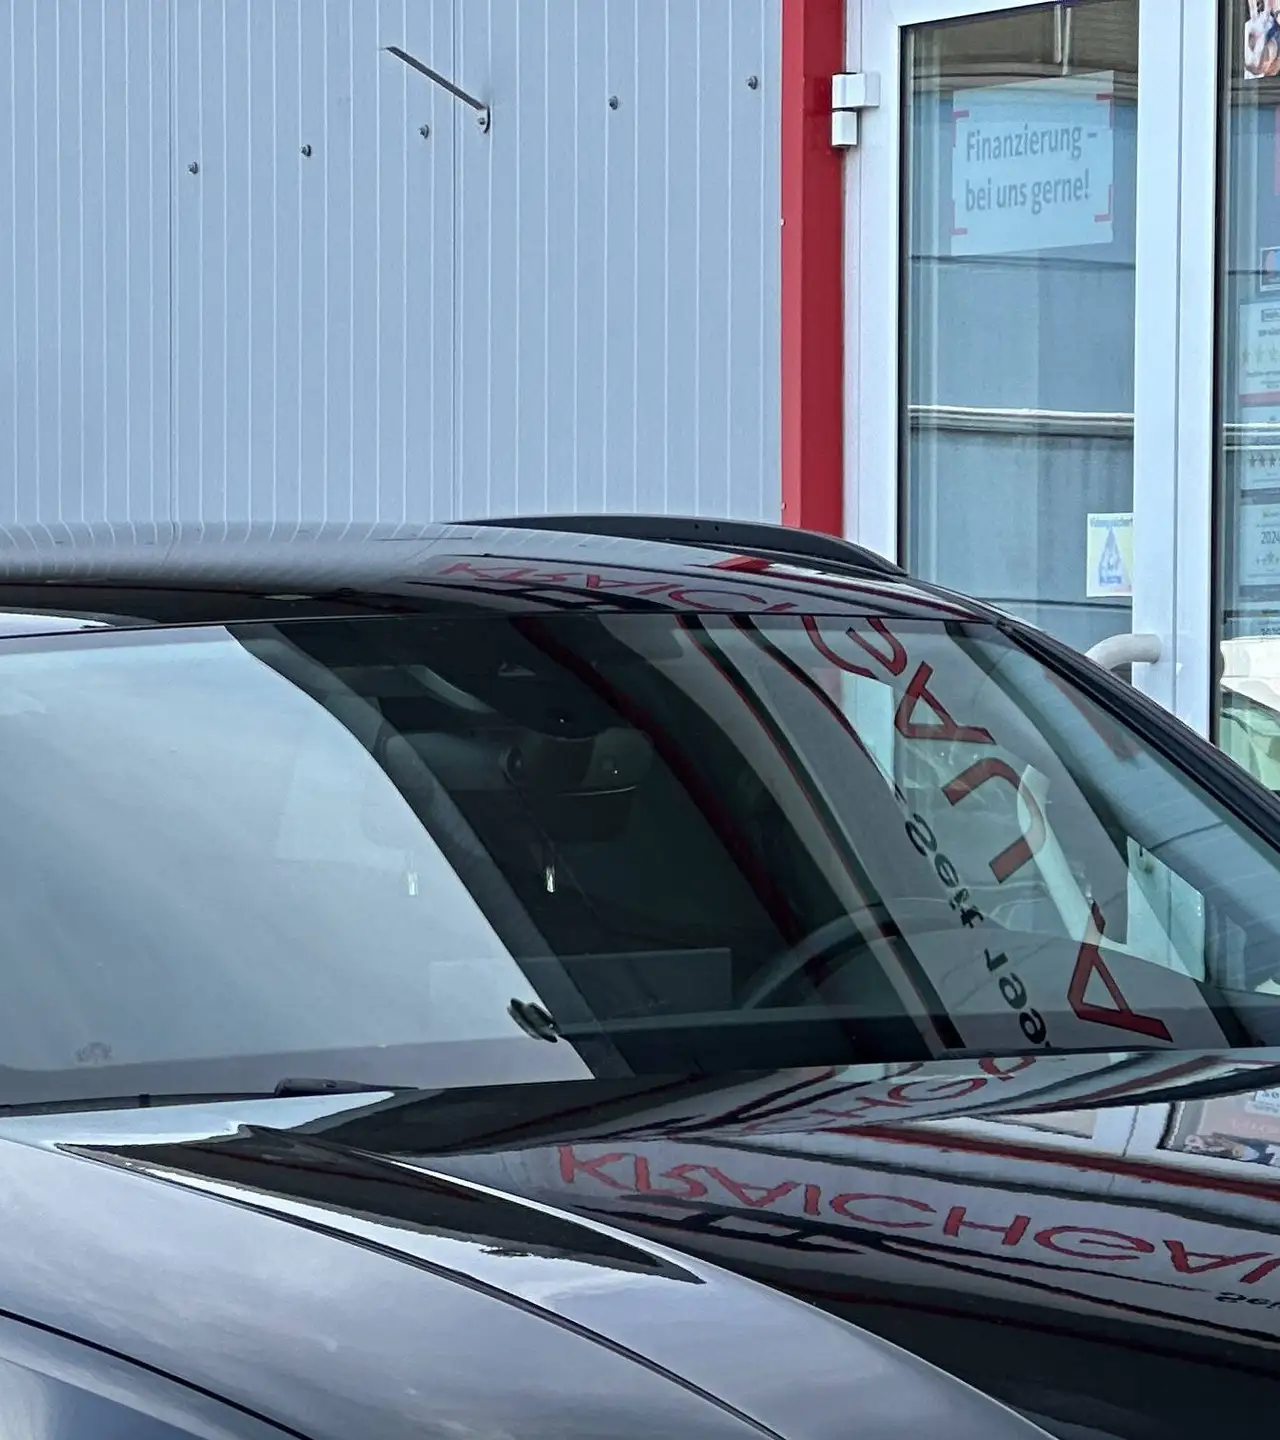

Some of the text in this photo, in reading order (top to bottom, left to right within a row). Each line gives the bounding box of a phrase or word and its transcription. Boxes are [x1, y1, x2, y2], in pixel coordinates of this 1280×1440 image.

[966, 122, 1084, 163] Finanzierung
[965, 167, 1091, 216] bei uns gerne!
[1260, 531, 1280, 545] 2024
